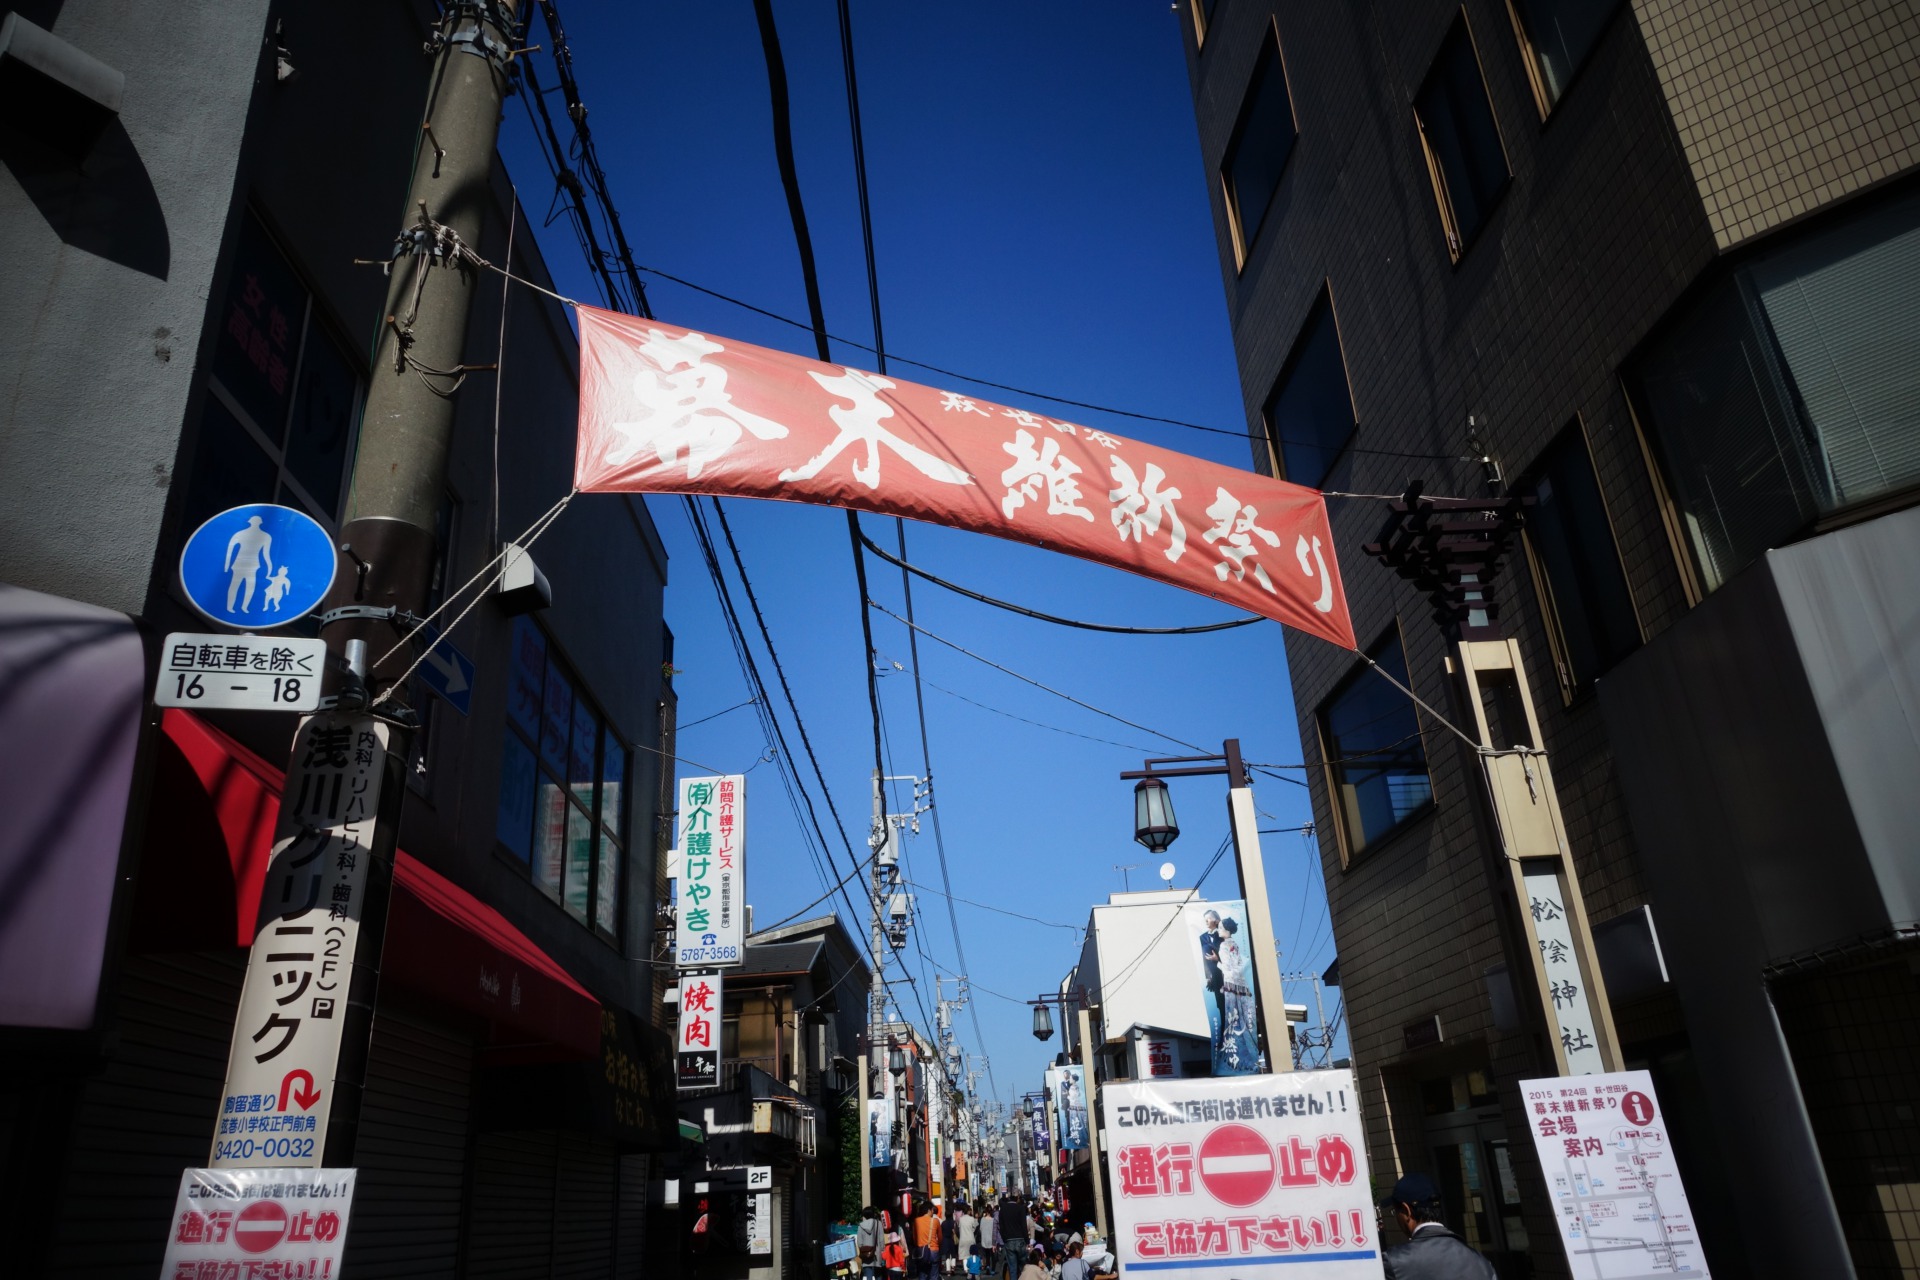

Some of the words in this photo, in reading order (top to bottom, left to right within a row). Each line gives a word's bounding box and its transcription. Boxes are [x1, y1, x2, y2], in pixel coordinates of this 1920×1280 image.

[606, 327, 1334, 613] 幕末維新祭り
[171, 642, 315, 671] 自転車を除く
[176, 673, 205, 699] 16
[273, 677, 301, 703] 18
[719, 780, 734, 870] 訪問介護サービス
[252, 725, 353, 1064] 浅川クリニック
[681, 945, 737, 962] 5787-3568
[1530, 896, 1594, 1075] 松陰神社
[684, 981, 715, 1048] 焼肉
[1148, 1041, 1173, 1076] 不動産
[224, 1094, 276, 1113] 駒留通り
[1529, 1090, 1553, 1100] 2015
[1560, 1087, 1588, 1098] 第24回
[1533, 1096, 1618, 1115] 幕末維新祭り
[220, 1115, 317, 1134] 弦巻小学校正門前角
[1538, 1115, 1578, 1138] 会場
[215, 1138, 315, 1161] 3420-0032
[1563, 1136, 1604, 1159] 案内
[750, 1172, 768, 1184] 2F
[1117, 1141, 1195, 1199] 通行
[1277, 1133, 1358, 1189] 止め
[175, 1209, 235, 1245] 通行
[286, 1208, 342, 1244] 止め
[1134, 1208, 1369, 1260] ご協力下さい!!
